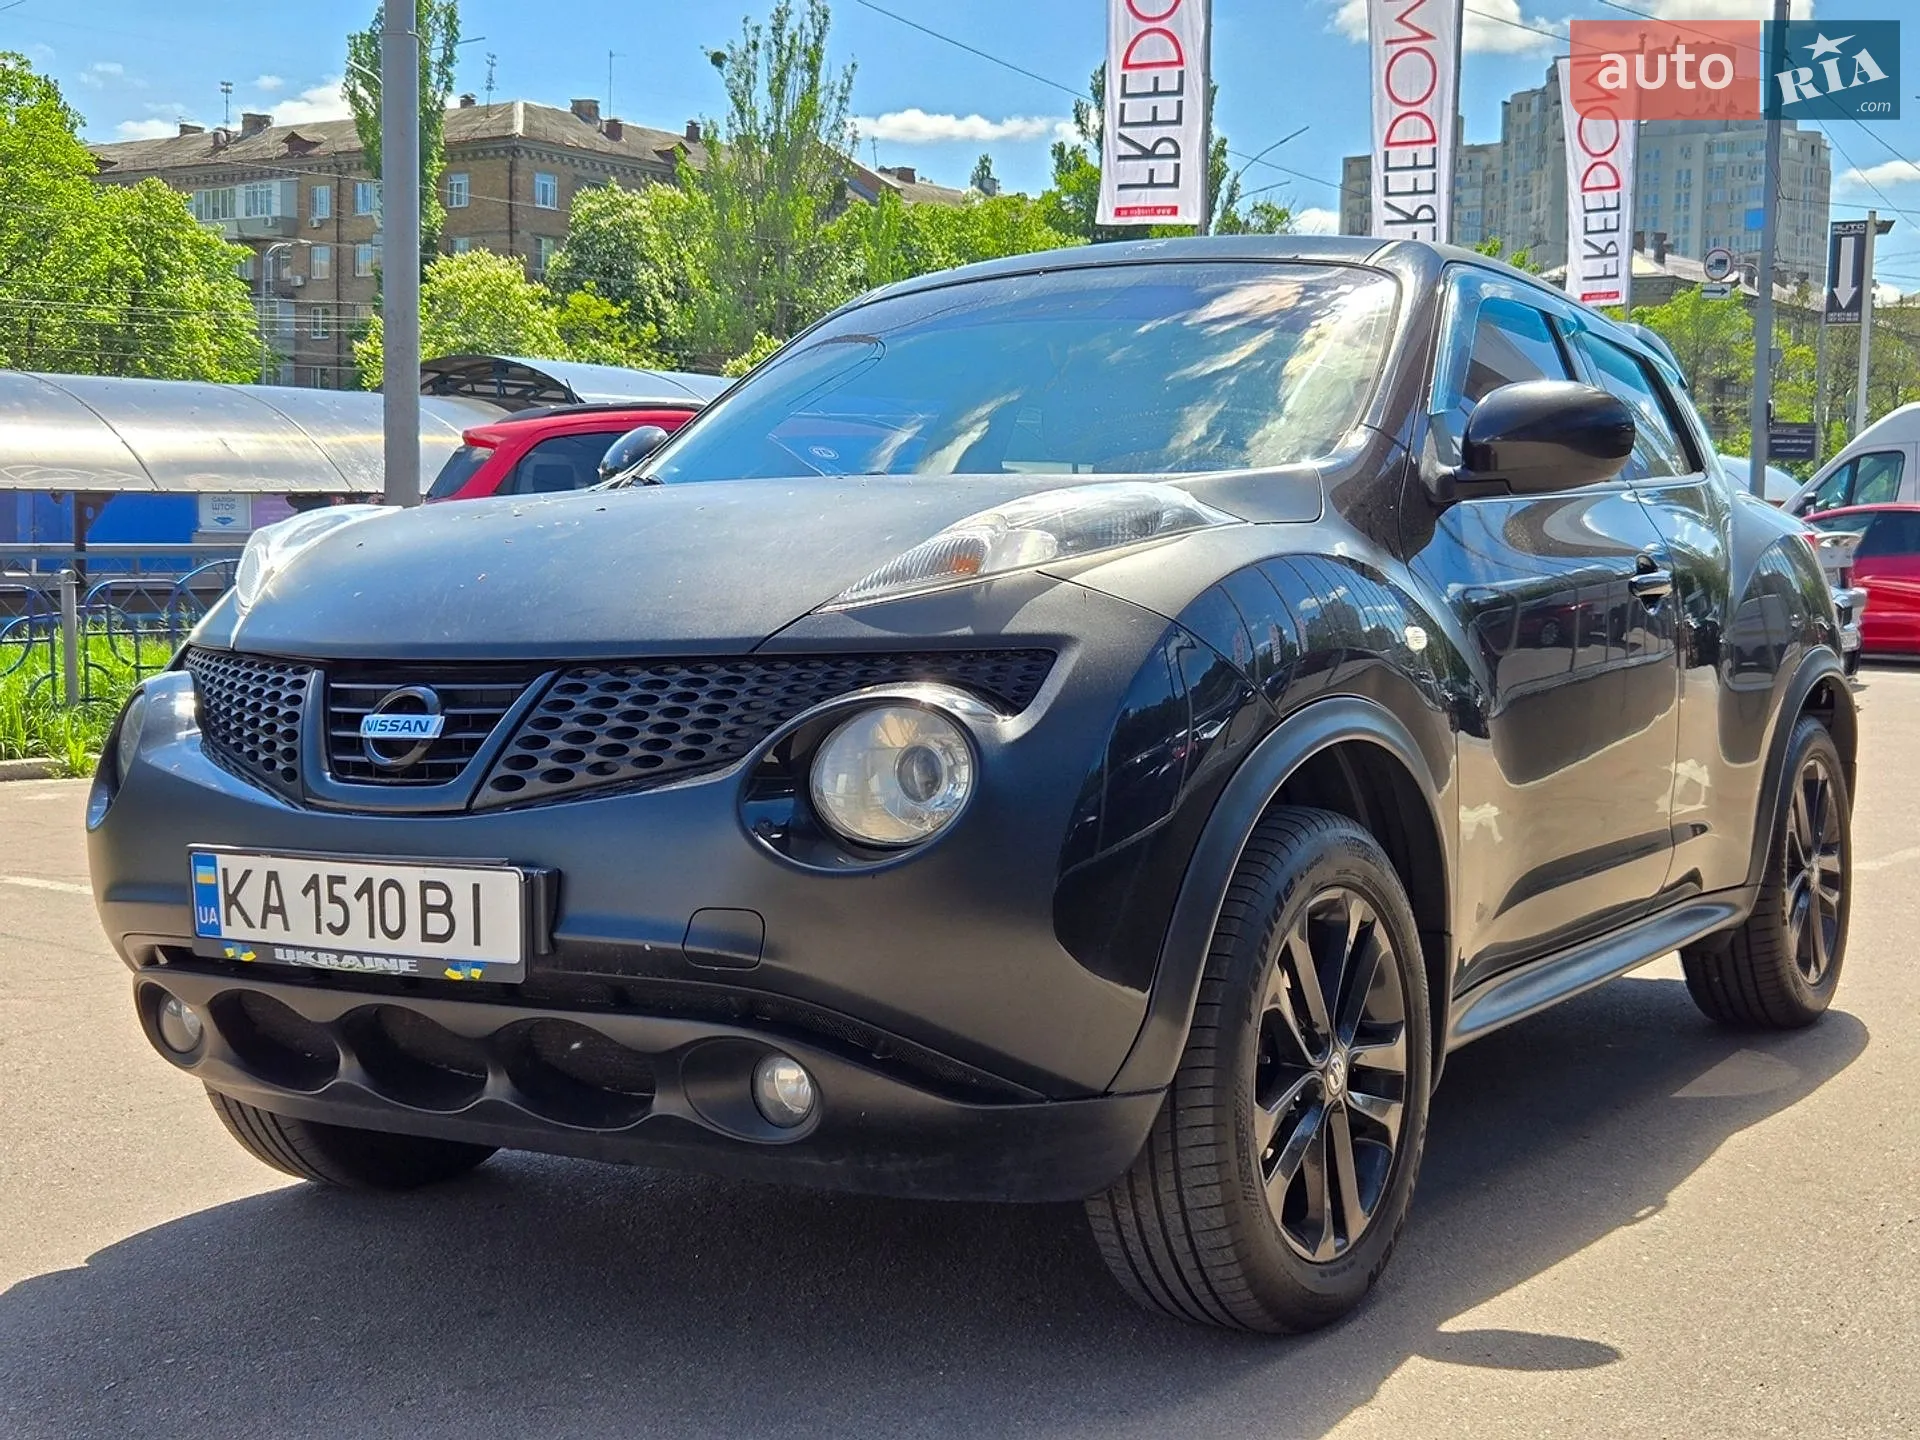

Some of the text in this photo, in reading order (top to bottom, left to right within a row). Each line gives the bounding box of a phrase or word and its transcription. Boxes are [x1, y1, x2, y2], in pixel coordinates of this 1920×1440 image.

[211, 503, 236, 511] ШТОР
[364, 719, 429, 733] NISSAN
[199, 906, 218, 925] UA
[222, 868, 480, 946] KA 1510 BI
[274, 948, 418, 974] UKRAINE
